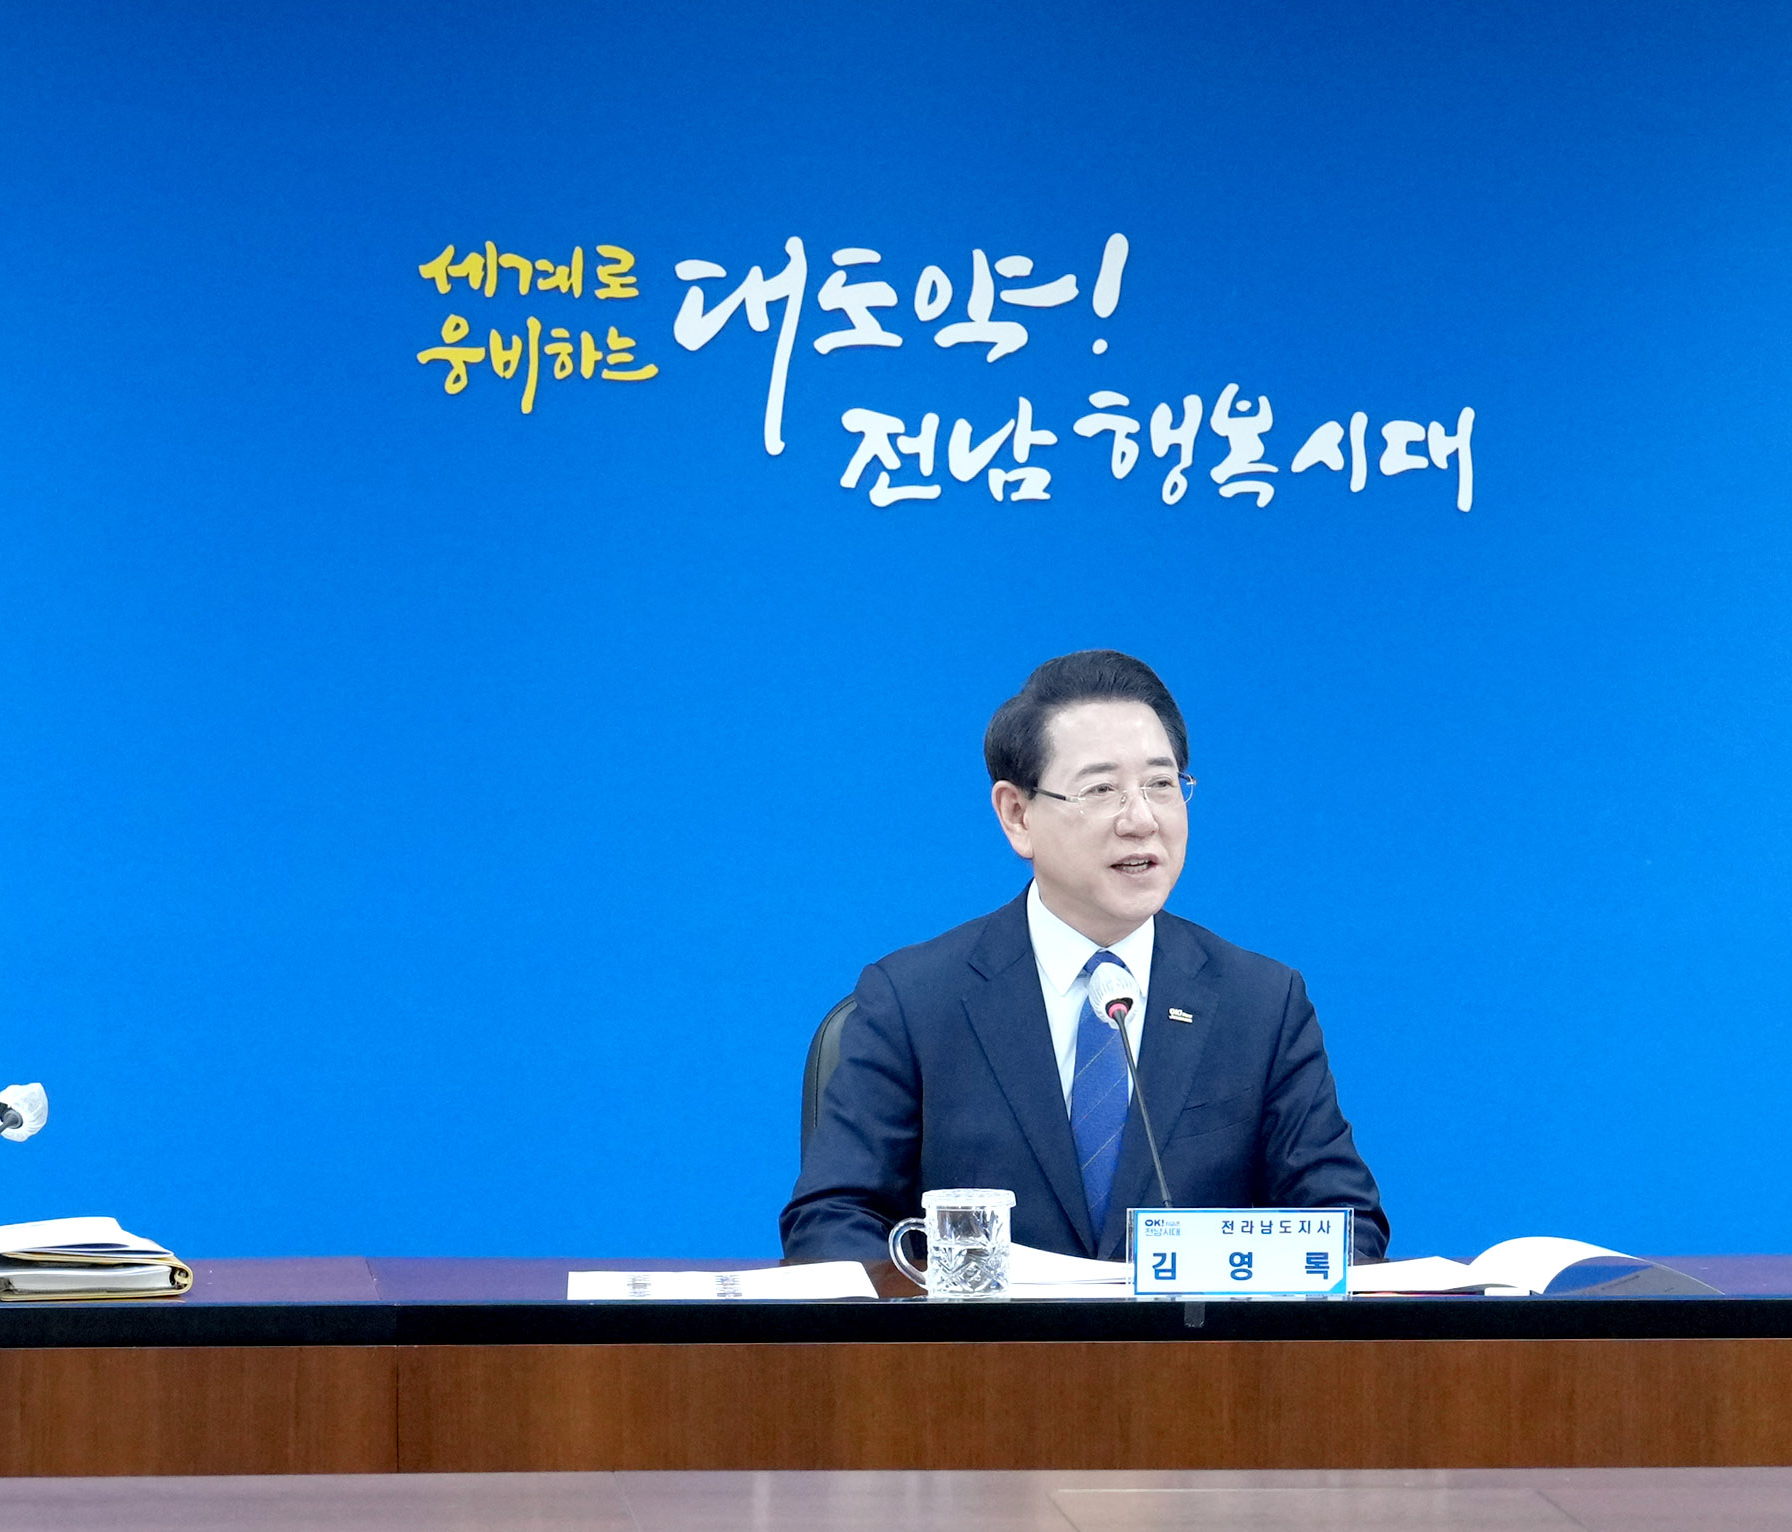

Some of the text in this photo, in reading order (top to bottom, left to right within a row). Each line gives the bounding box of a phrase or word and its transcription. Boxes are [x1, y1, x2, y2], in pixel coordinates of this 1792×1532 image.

[418, 242, 640, 299] 세계로
[416, 314, 659, 414] 웅비하는
[673, 233, 1129, 455] 대도약!
[839, 396, 1058, 508] 전남
[1221, 1219, 1331, 1235] 전라남도지사
